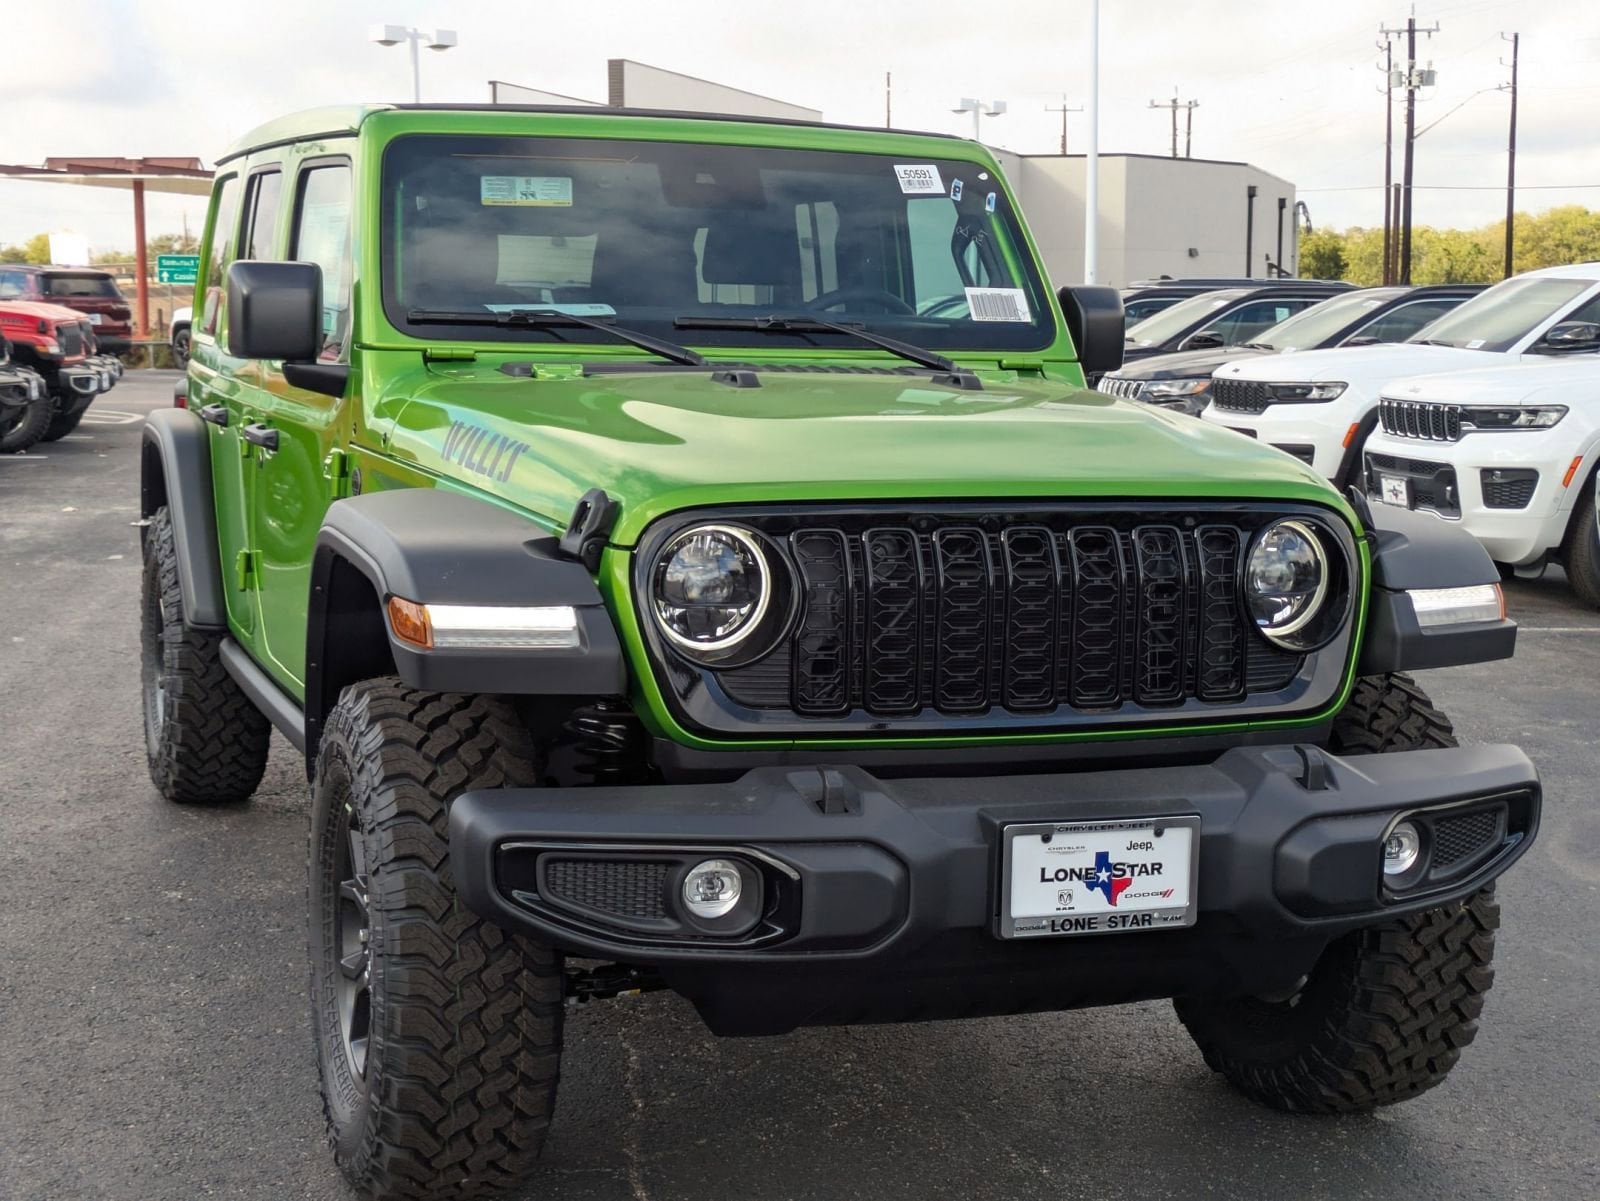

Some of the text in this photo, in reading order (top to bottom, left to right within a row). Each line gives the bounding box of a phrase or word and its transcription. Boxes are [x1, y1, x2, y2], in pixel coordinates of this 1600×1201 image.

[897, 169, 933, 179] L50591
[441, 420, 530, 483] WILLYS
[1057, 824, 1114, 832] CHRYSLER
[1126, 840, 1153, 851] Jeep
[1040, 862, 1163, 883] LONE STAR
[1051, 917, 1098, 933] LONE
[1107, 913, 1153, 929] STAR
